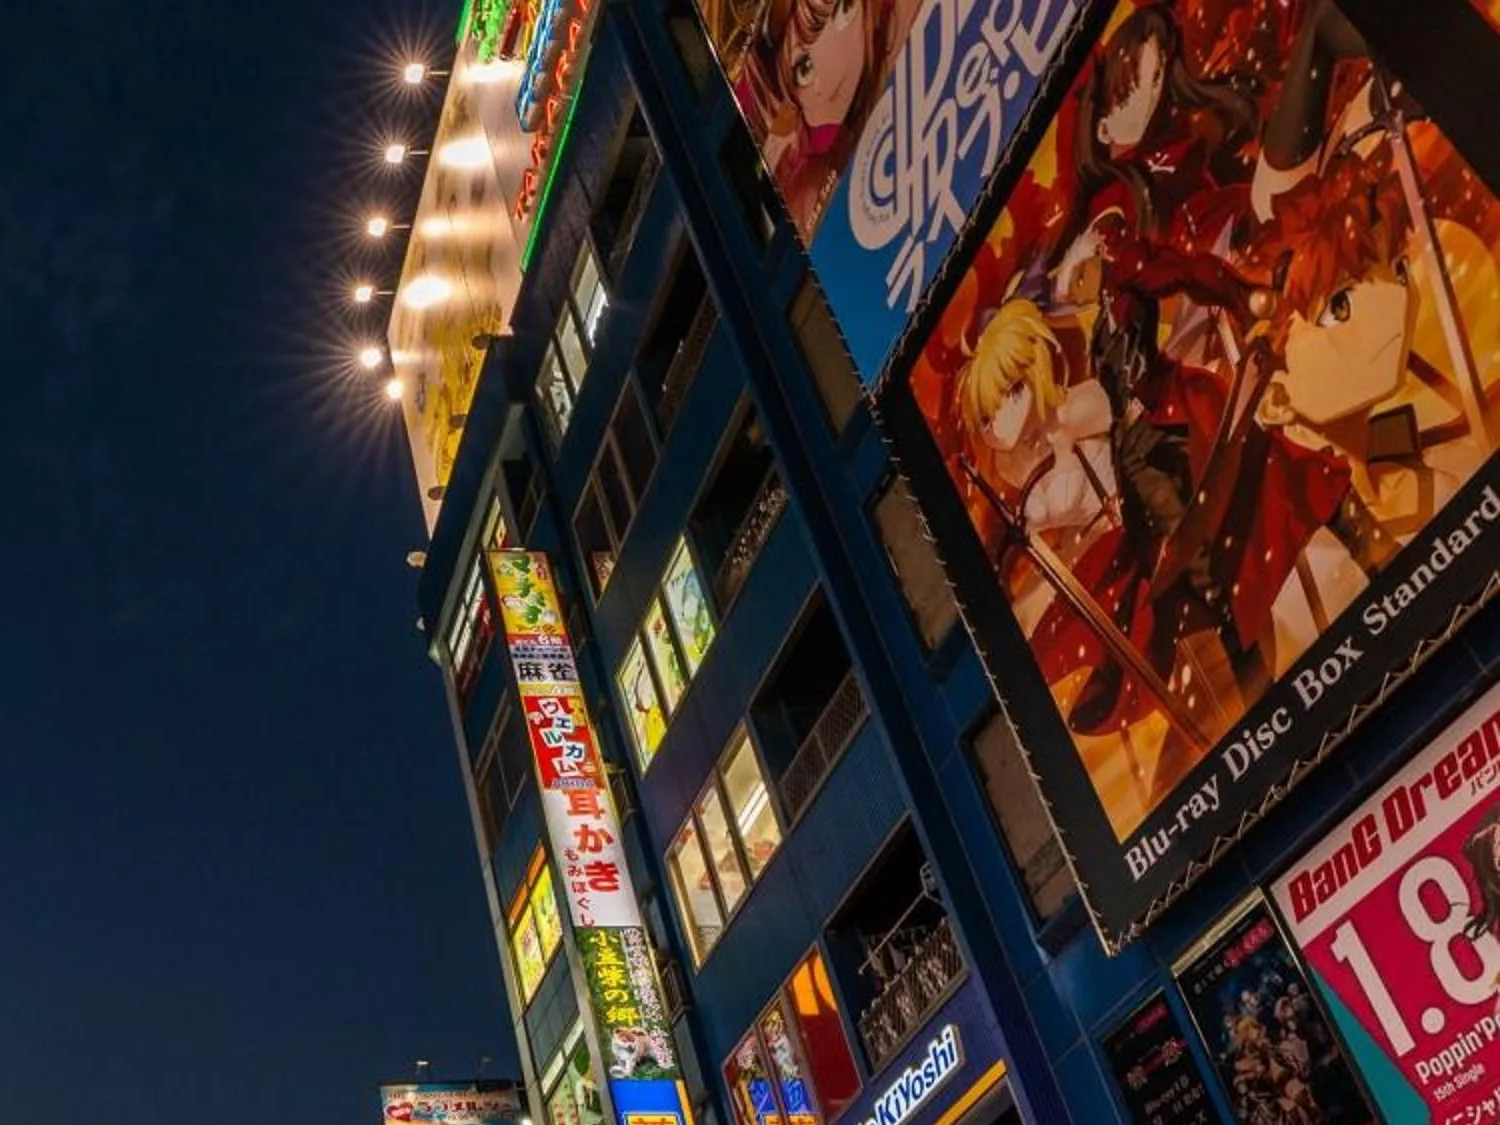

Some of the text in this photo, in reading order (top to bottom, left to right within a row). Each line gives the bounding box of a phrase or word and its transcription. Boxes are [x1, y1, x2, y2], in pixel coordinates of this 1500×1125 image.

[517, 661, 578, 683] 麻雀
[1125, 485, 1500, 882] Blu-ray Disc Box Standard
[567, 792, 621, 892] 耳かき
